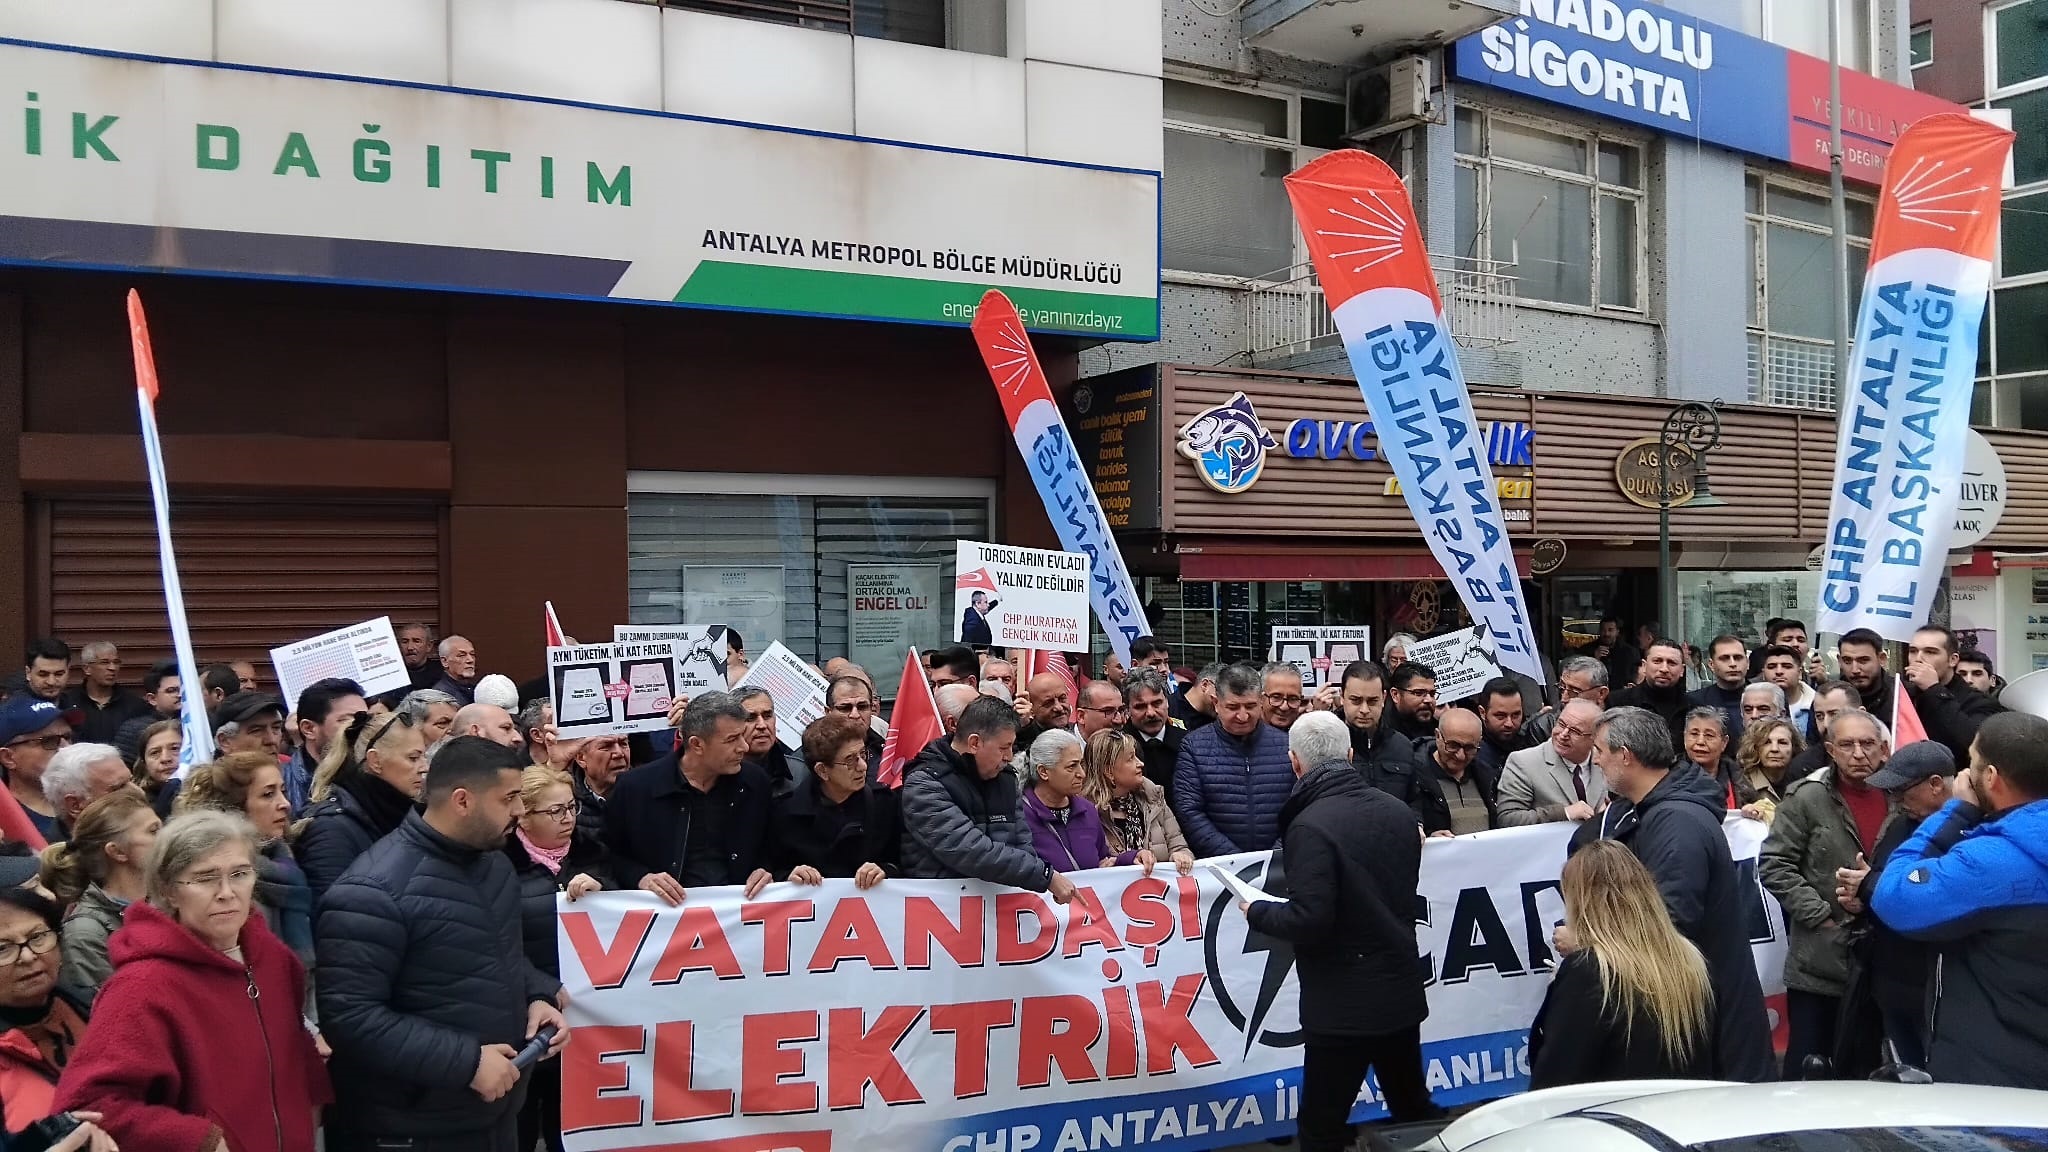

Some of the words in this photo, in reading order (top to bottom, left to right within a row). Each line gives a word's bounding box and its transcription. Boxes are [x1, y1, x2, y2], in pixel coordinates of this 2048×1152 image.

[1481, 18, 1692, 122] SİGORTA
[196, 122, 633, 207] DAĞITIM
[701, 228, 805, 258] ANTALYA
[811, 239, 927, 269] METROPOL
[932, 248, 996, 275] BÖLGE
[1002, 255, 1122, 286] MÜDÜRLÜĞÜ
[1031, 309, 1123, 332] yanınızdayız
[1842, 279, 1913, 511] ANTALYA
[1122, 406, 1147, 427] yemi
[1882, 282, 1957, 567] BAŞKANLIĞI
[1100, 427, 1123, 444] sülük
[1099, 444, 1125, 460] tavuk
[1096, 462, 1128, 477] karides
[1094, 479, 1131, 494] kalamar
[1960, 483, 1999, 502] ILVER
[1963, 519, 1982, 534] KOÇ
[978, 546, 1045, 568] TOROSLARIN
[1047, 554, 1085, 571] EVLADI
[1823, 516, 1867, 613] CHP
[855, 587, 885, 596] ORTAK
[886, 587, 911, 596] OLMA
[996, 570, 1034, 589] YALNIZ
[1036, 573, 1085, 593] DEĞİLDİR
[855, 596, 903, 611] ENGEL
[905, 595, 928, 610] OL!
[1865, 580, 1917, 619] İL
[1003, 612, 1022, 625] CHP
[1024, 614, 1077, 632] MURATPAŞA
[619, 632, 628, 641] BU
[629, 631, 651, 641] ZAMMI
[1002, 627, 1039, 643] GENÇLİK
[1042, 631, 1078, 644] KOLLARI
[1276, 629, 1290, 639] AYNI
[1291, 627, 1319, 640] TÜKETİM,
[1320, 627, 1328, 639] İKİ
[1329, 629, 1341, 639] KAT
[1342, 629, 1365, 639] FATURA
[553, 650, 572, 663] AYNI
[574, 645, 612, 661] TÜKETİM,
[613, 644, 625, 658] İKİ
[626, 645, 641, 657] KAT
[643, 643, 673, 656] FATURA
[560, 875, 1205, 990] VATANDAŞI
[560, 957, 1221, 1136] ELEKTRİK
[1053, 1093, 1264, 1152] ANTALYA
